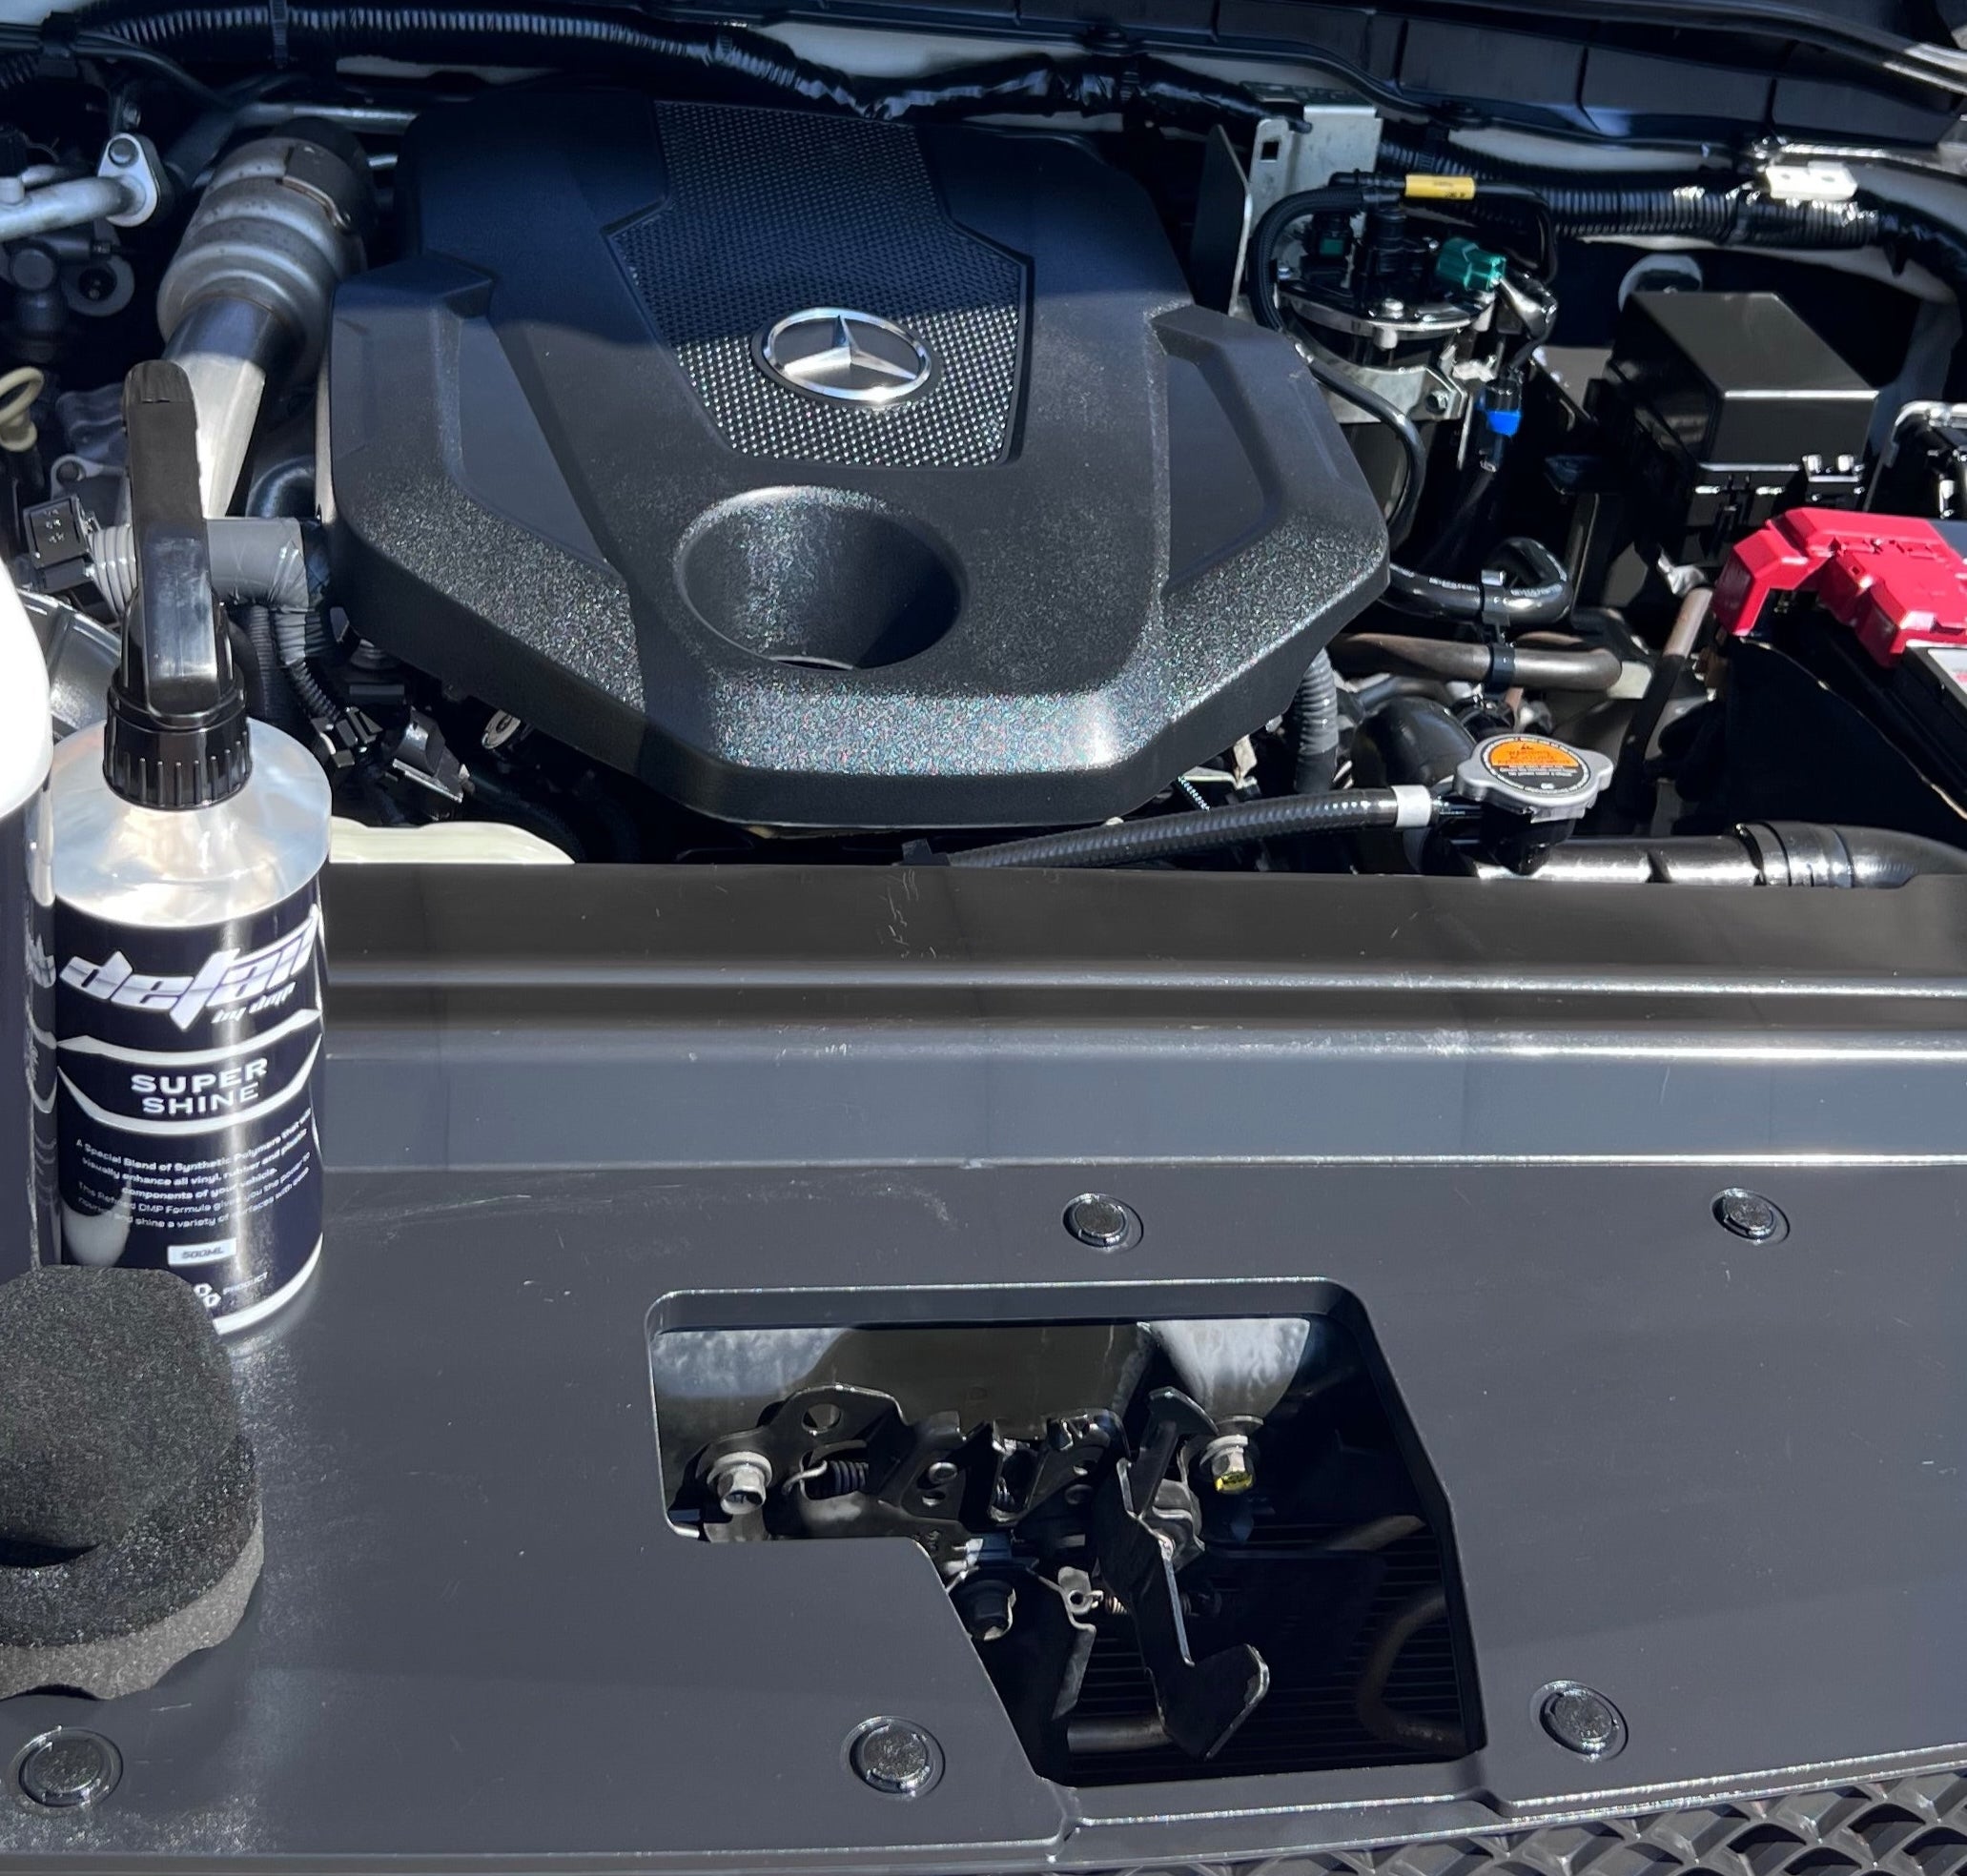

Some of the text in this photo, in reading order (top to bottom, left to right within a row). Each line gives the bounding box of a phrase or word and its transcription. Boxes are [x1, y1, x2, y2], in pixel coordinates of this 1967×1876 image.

[130, 1057, 268, 1094] SUPER
[142, 1082, 259, 1114] SHINE
[76, 1138, 83, 1147] A
[84, 1143, 121, 1164] Special
[123, 1157, 156, 1171] Blend
[158, 1163, 172, 1172] of
[174, 1157, 232, 1172] Synthetic
[234, 1136, 281, 1161] Polymers
[82, 1157, 120, 1179] visually
[122, 1173, 172, 1186] enhance
[191, 1172, 221, 1184] vinyl,
[223, 1161, 260, 1178] rubber
[261, 1149, 280, 1165] and
[121, 1188, 193, 1199] components
[195, 1190, 209, 1199] of
[210, 1183, 238, 1198] your
[138, 1203, 163, 1213] DMP
[165, 1204, 211, 1213] Formula
[263, 1179, 279, 1192] the
[135, 1218, 165, 1228] shine
[176, 1217, 216, 1228] variety
[181, 1246, 224, 1259] 500ML
